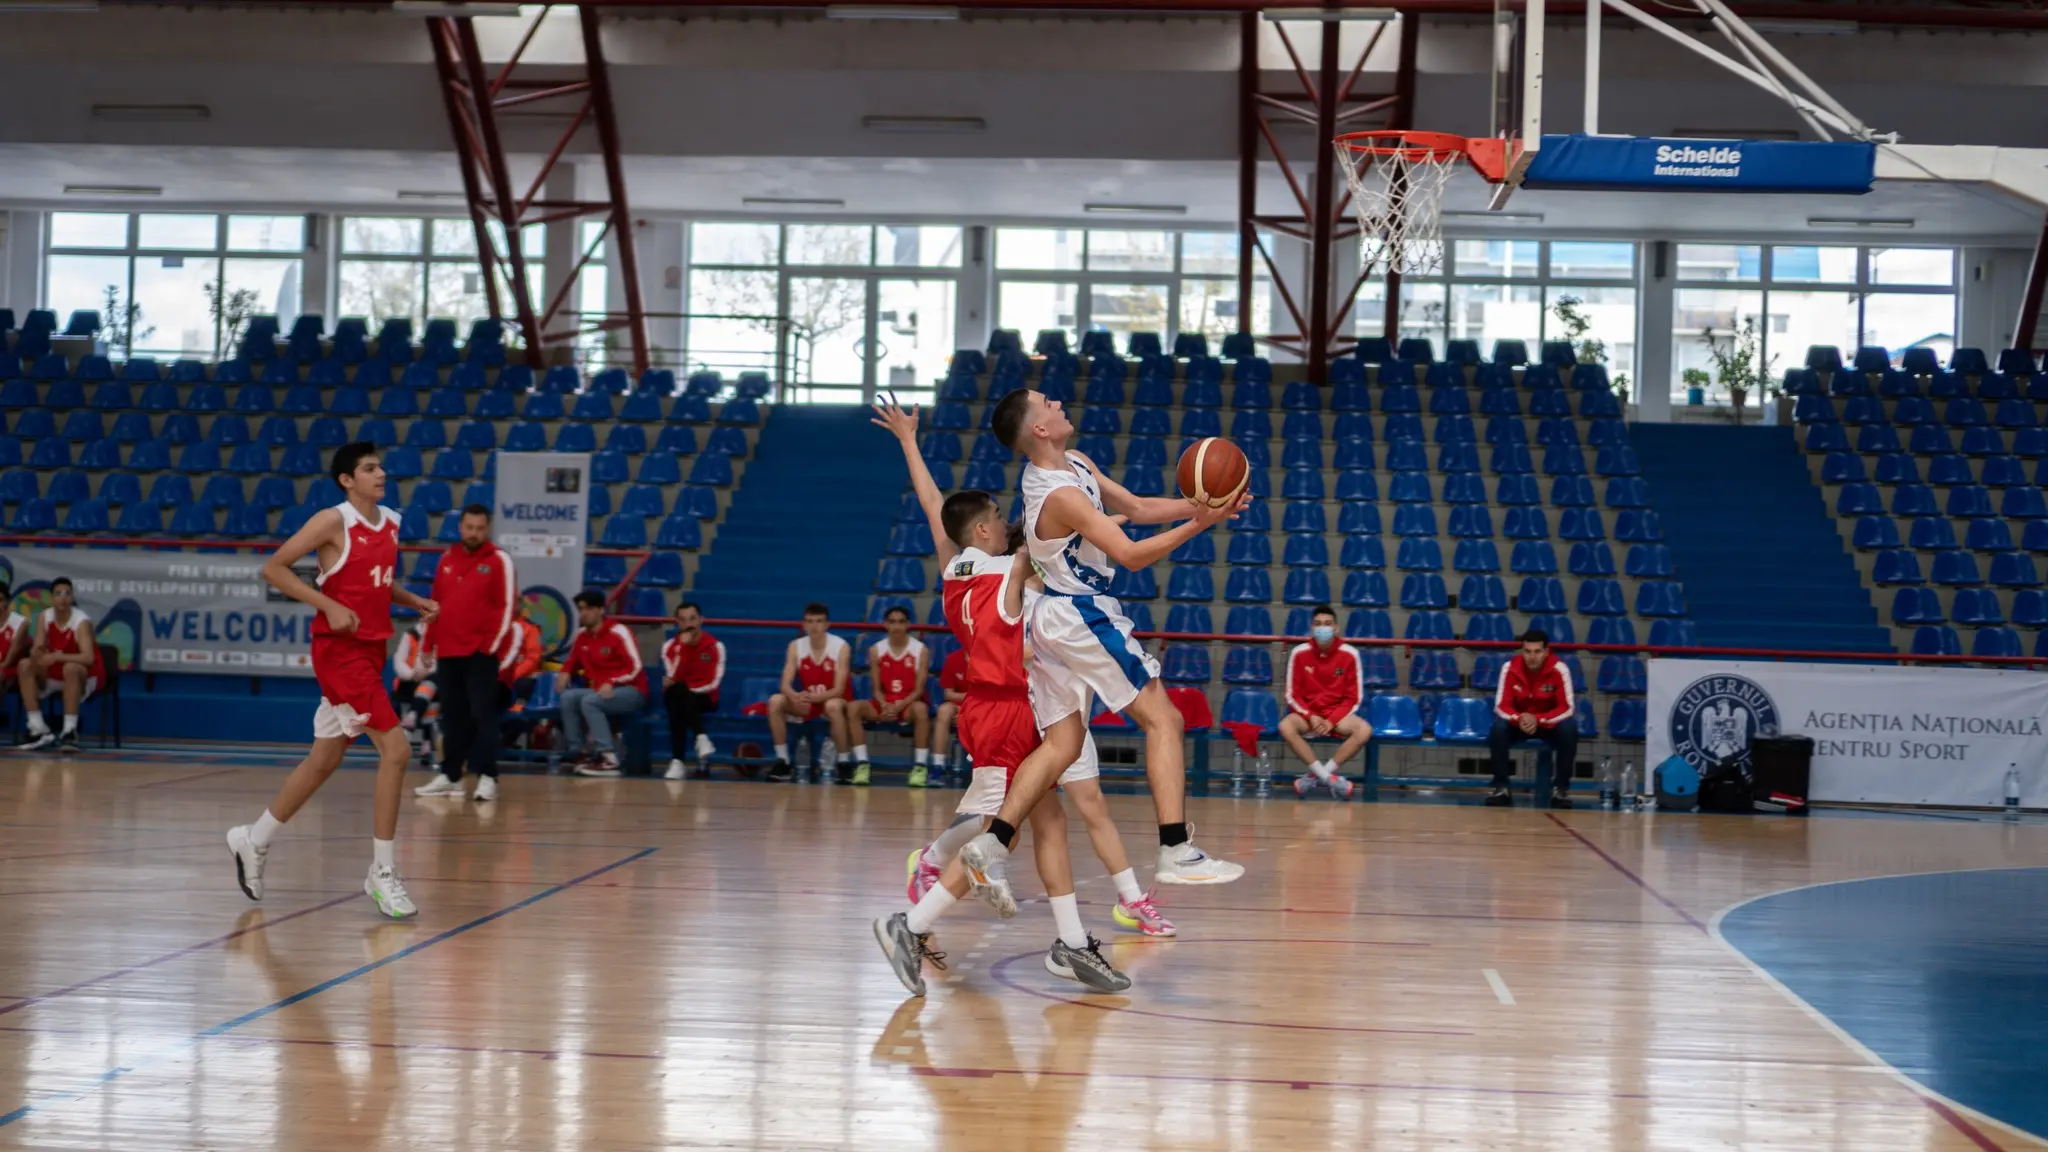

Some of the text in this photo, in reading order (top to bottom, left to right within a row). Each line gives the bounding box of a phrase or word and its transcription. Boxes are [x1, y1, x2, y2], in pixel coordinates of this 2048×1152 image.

[1656, 145, 1741, 163] Schelde
[1654, 164, 1740, 177] International
[501, 503, 579, 521] WELCOME
[370, 565, 393, 588] 14
[120, 580, 216, 596] DEVELOPMENT
[962, 588, 974, 636] 4
[891, 679, 902, 693] 5
[1679, 679, 1771, 718] GUVERNUL
[1812, 739, 1970, 760] ENTRU SPORT
